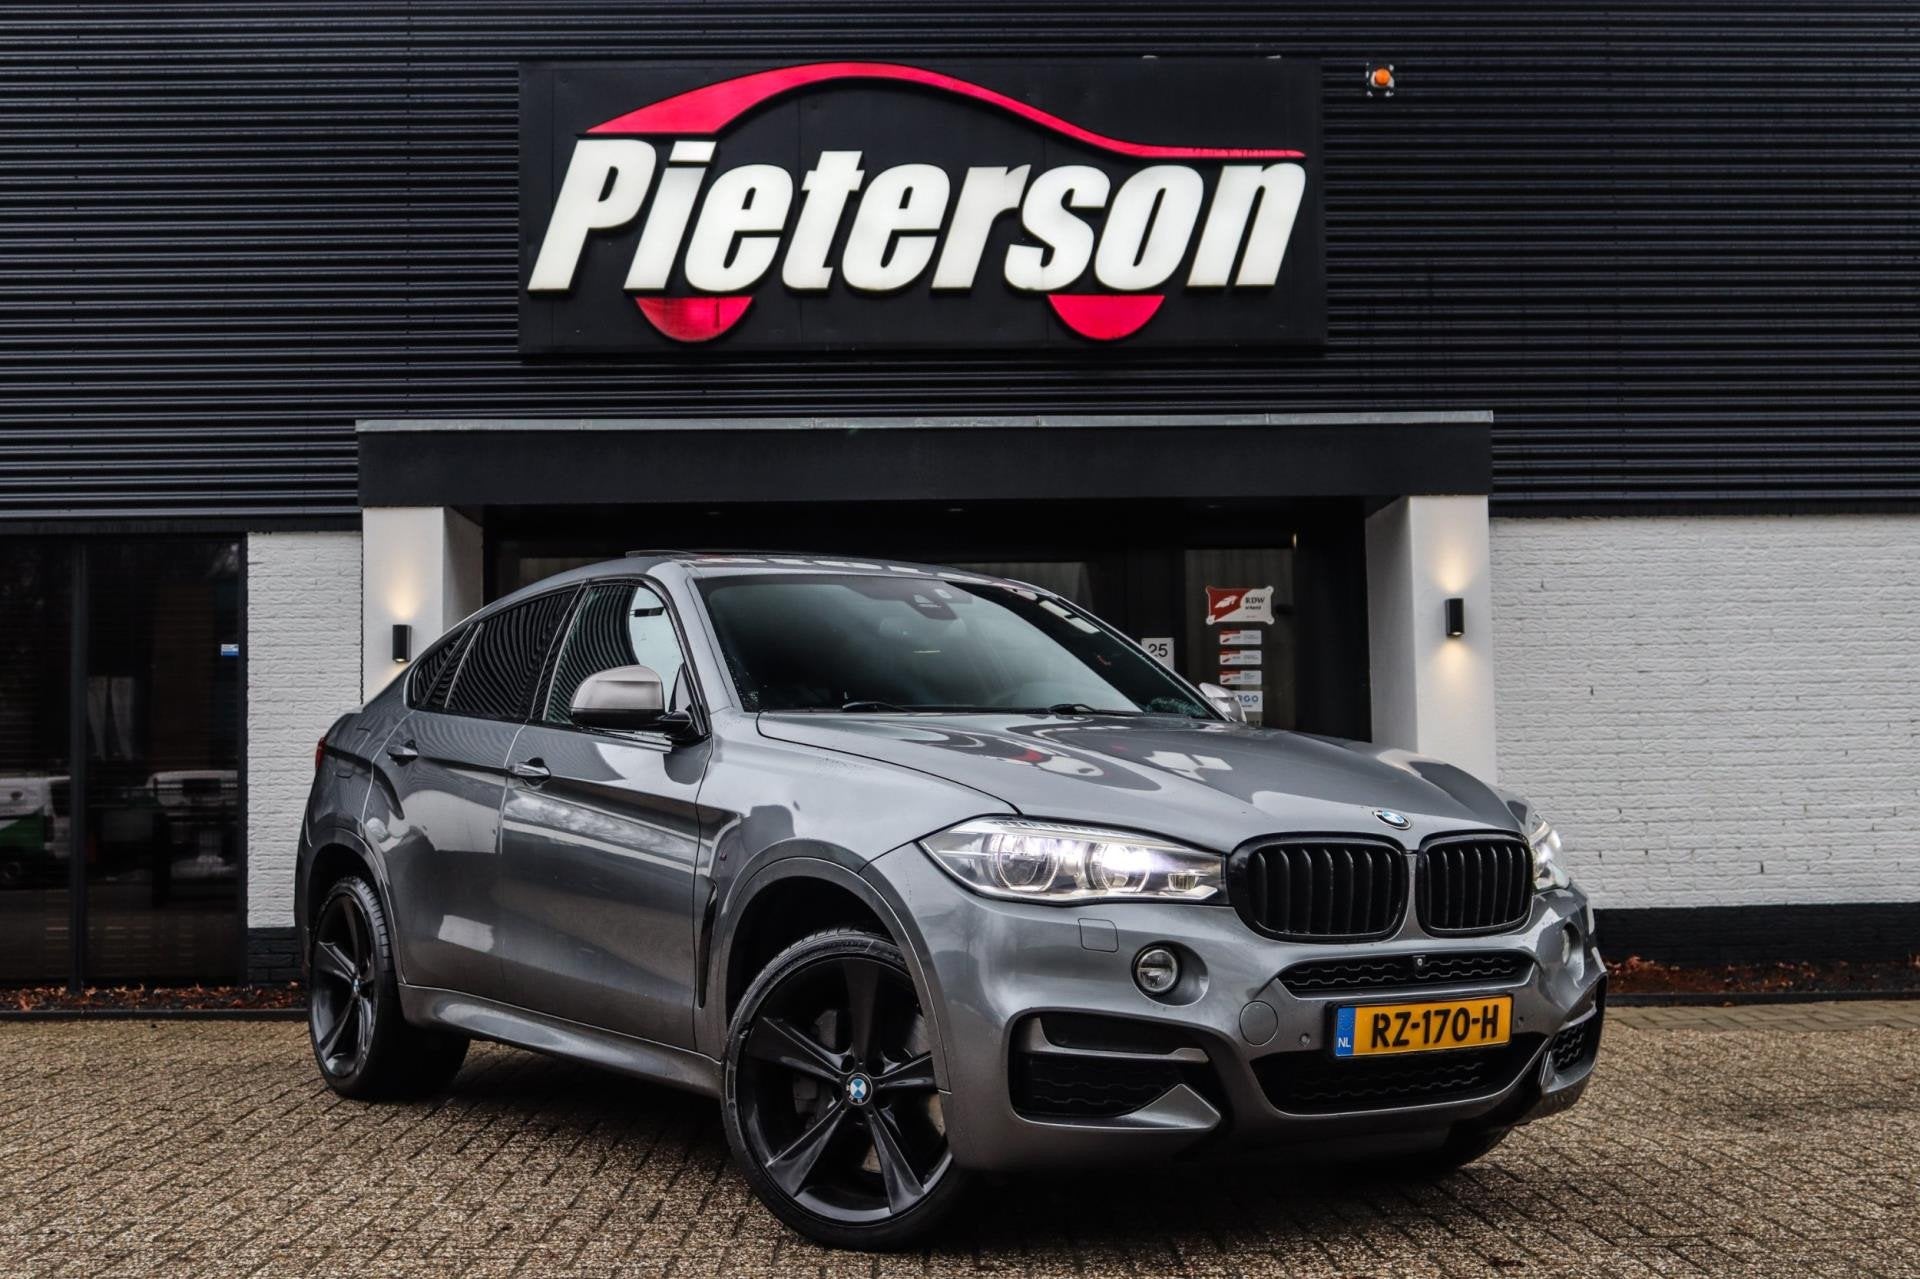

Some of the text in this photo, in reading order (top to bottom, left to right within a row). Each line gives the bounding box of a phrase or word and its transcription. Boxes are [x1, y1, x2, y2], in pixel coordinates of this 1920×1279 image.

[527, 138, 1306, 292] Pieterson
[1148, 643, 1168, 658] 25
[1371, 1004, 1499, 1048] RZ-170-H
[1338, 1036, 1351, 1047] NL
